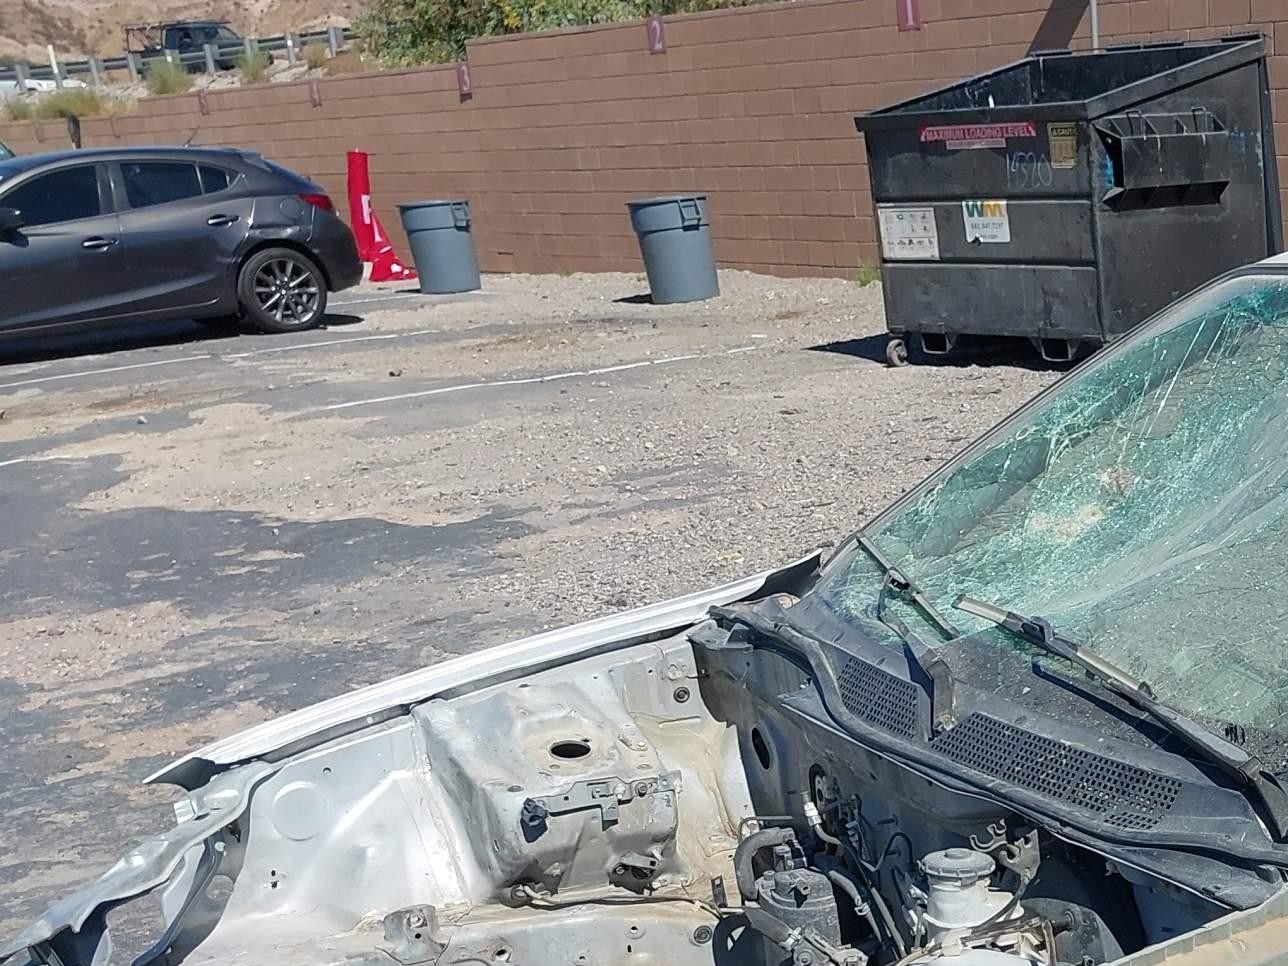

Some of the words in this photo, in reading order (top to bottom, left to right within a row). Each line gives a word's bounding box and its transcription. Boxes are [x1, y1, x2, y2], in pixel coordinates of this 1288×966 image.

[651, 20, 663, 49] 2
[462, 64, 470, 92] 3
[926, 128, 964, 141] MAXIMUM
[965, 126, 1001, 139] LOADING
[1004, 124, 1030, 137] LEVEL
[964, 200, 1005, 218] WM
